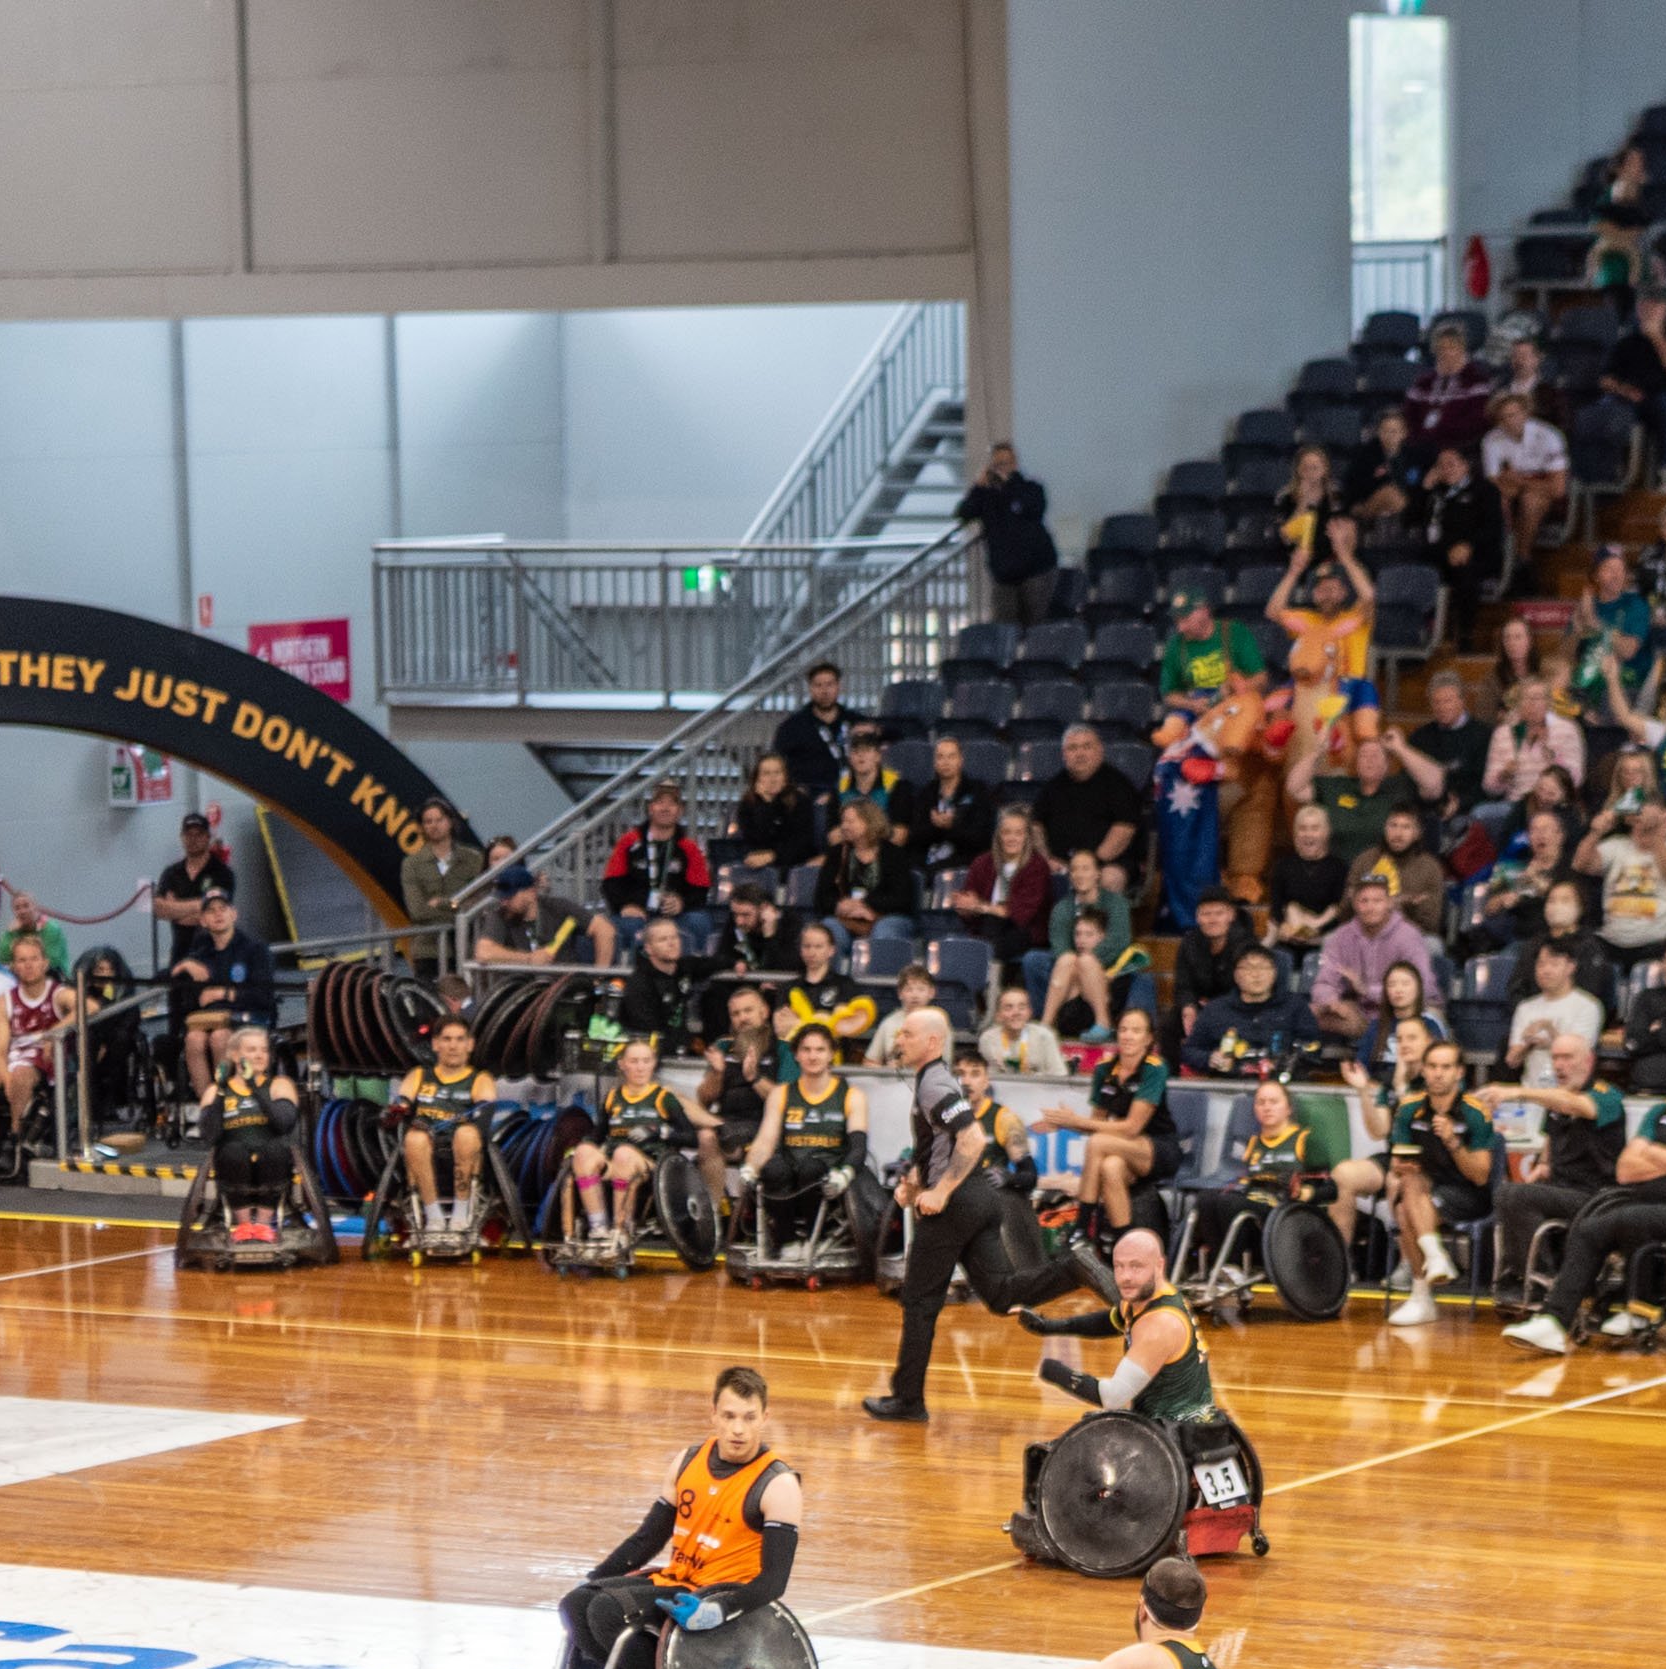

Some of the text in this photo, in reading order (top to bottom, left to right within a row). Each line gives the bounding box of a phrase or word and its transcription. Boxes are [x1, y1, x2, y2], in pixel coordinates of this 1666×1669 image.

[113, 666, 230, 725] JUST
[231, 700, 357, 787] DON'T
[348, 771, 427, 857] KNO
[1203, 1466, 1236, 1498] 3.5
[679, 1489, 695, 1519] 8
